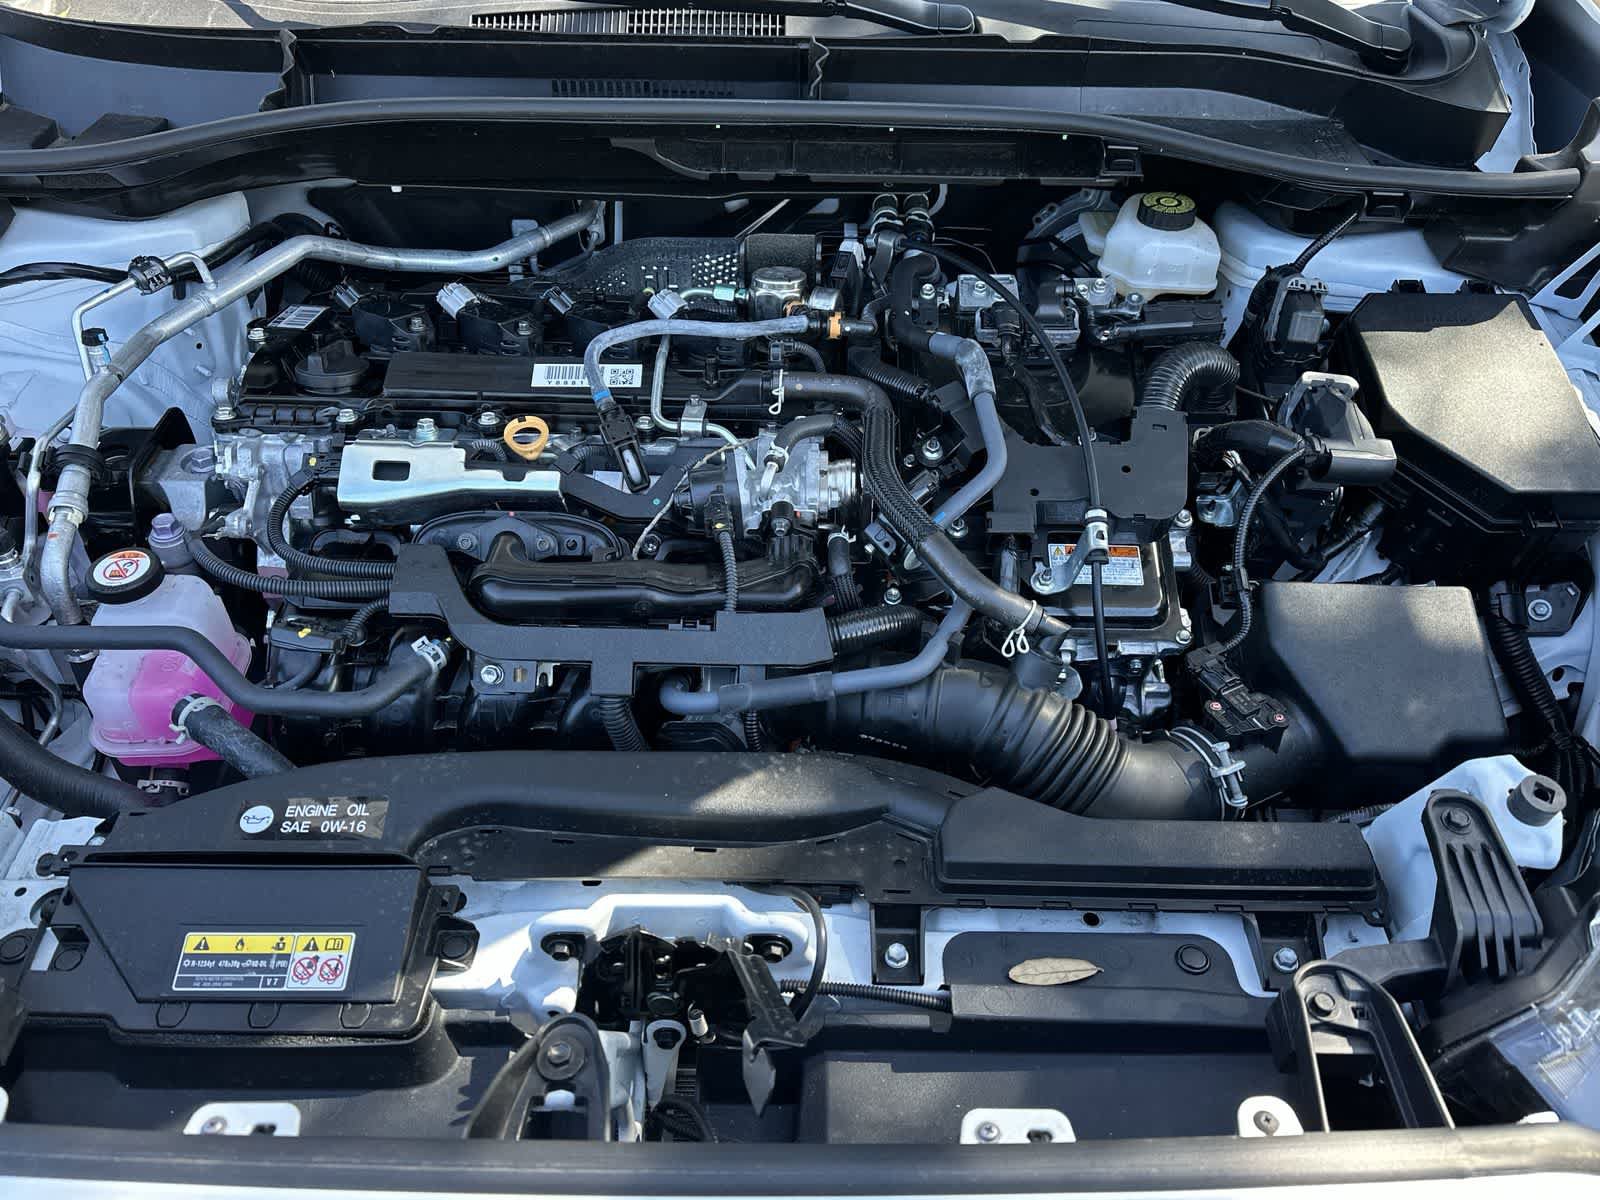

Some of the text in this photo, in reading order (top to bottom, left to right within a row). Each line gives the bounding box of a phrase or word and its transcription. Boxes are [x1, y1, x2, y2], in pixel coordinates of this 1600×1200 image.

[285, 804, 369, 817] ENGINE OIL
[280, 820, 366, 833] SAE 0W-16
